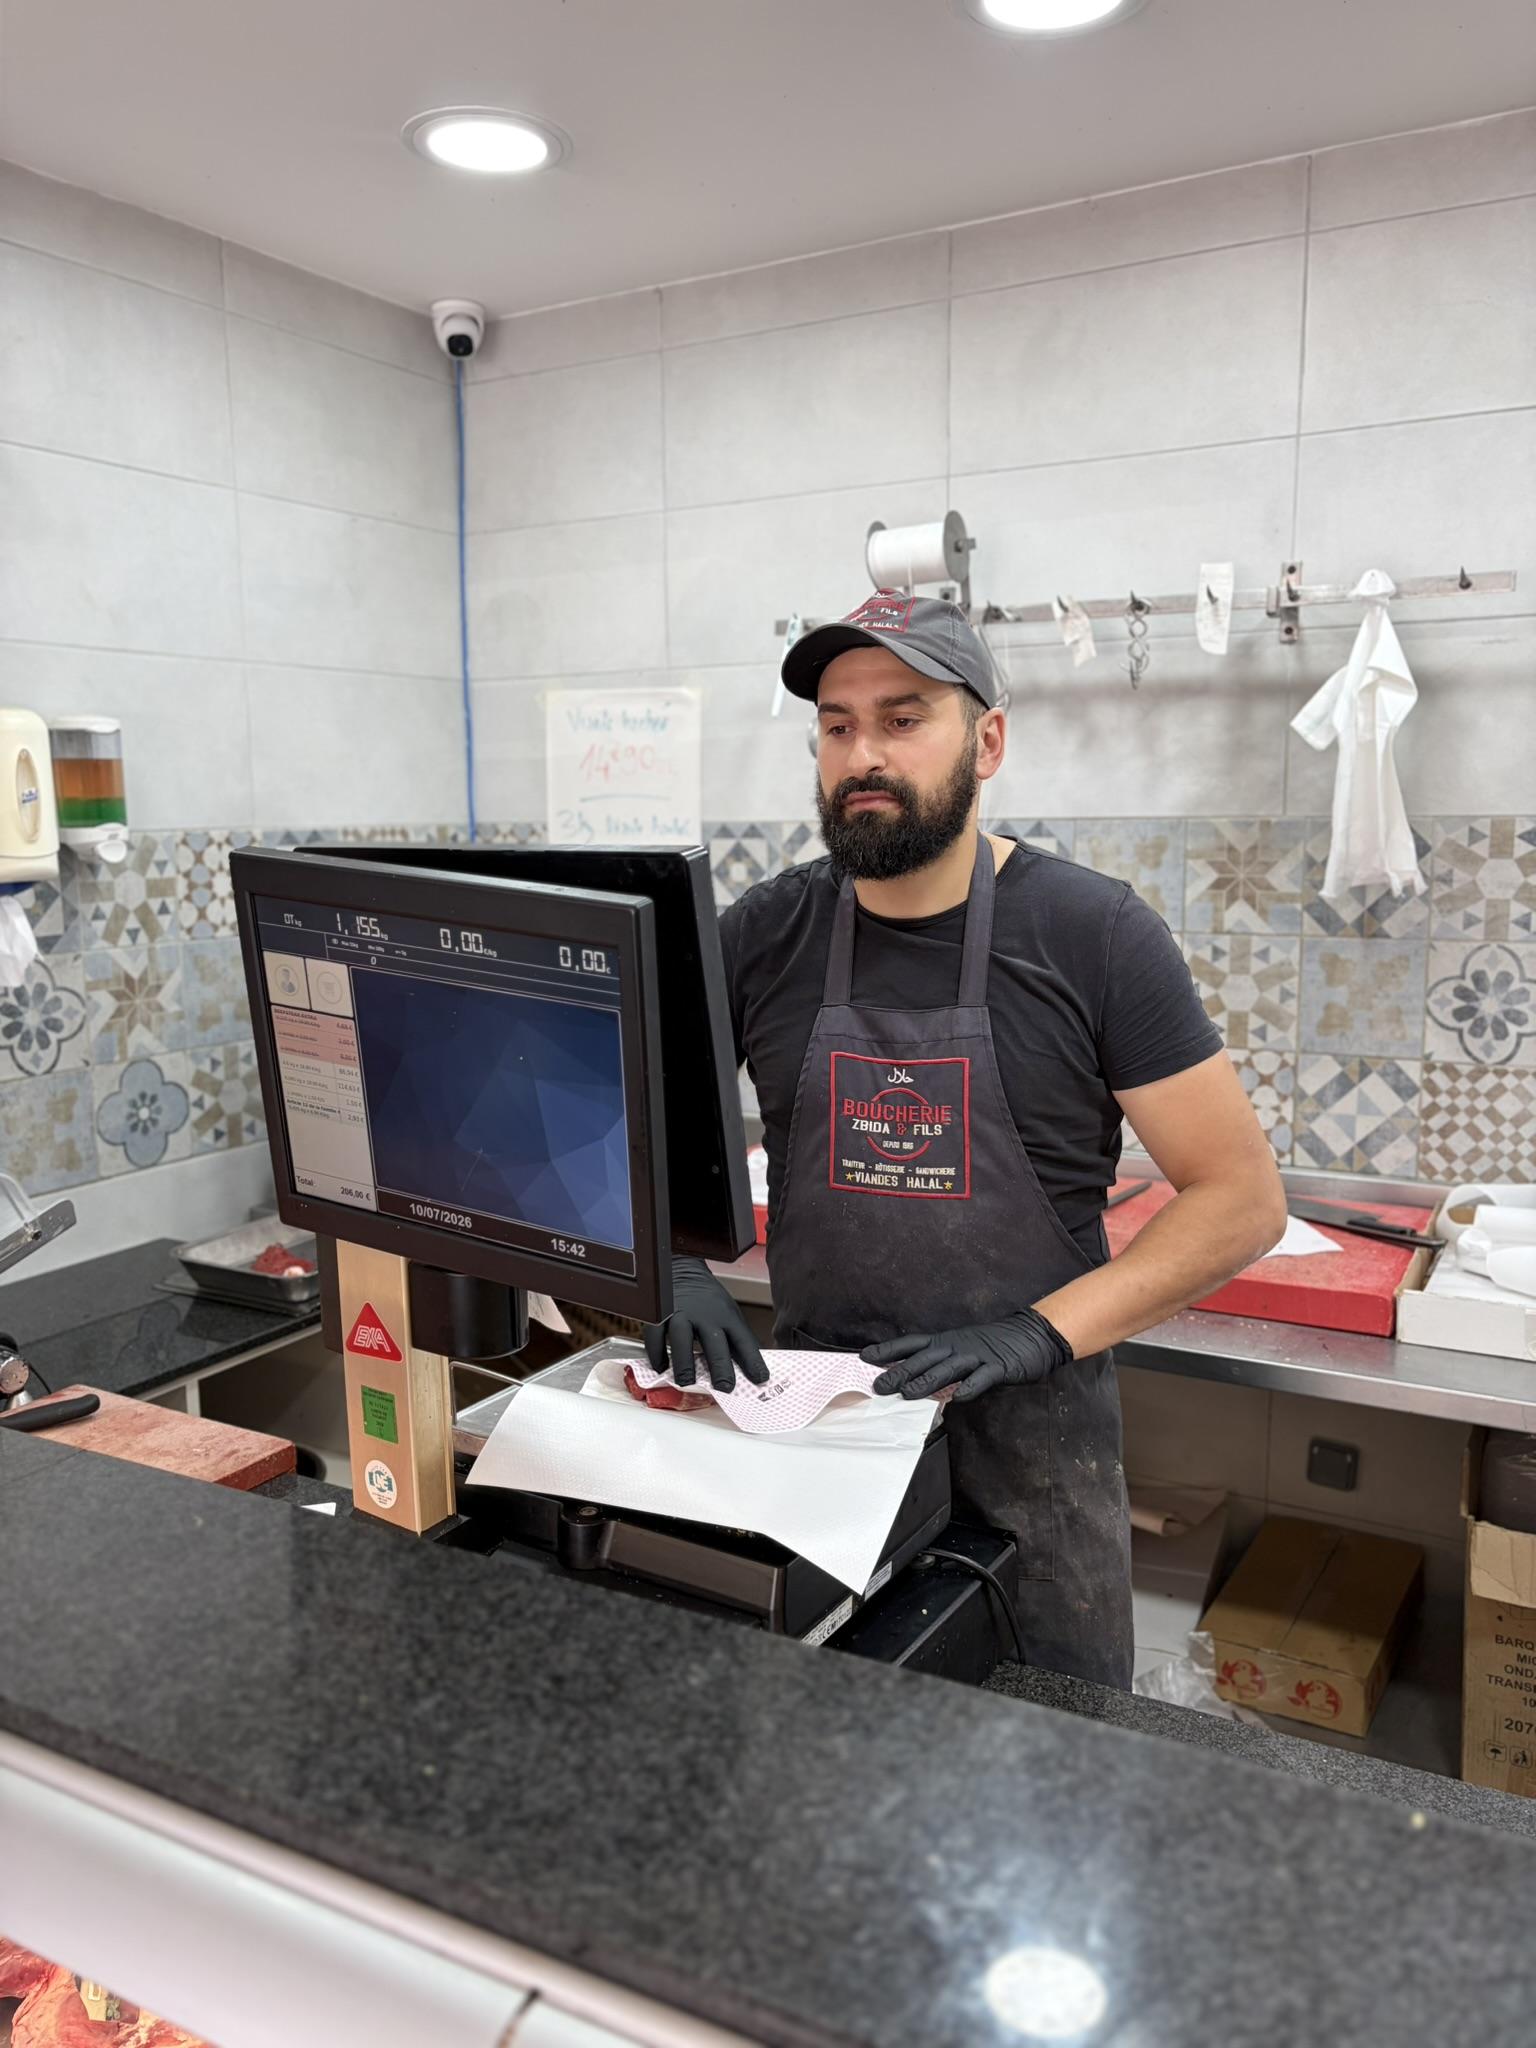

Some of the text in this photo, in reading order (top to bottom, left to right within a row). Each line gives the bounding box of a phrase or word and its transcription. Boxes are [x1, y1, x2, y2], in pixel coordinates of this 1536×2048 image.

[440, 928, 483, 953] 0,00
[559, 946, 606, 973] 0,00
[887, 1067, 914, 1084] حلال
[842, 1098, 953, 1125] BOUCHERIE
[852, 1118, 943, 1136] ZBIDA & FILS
[296, 1175, 314, 1186] Total
[854, 1171, 944, 1189] VIANDES HALAL
[340, 1186, 364, 1199] 206,00
[409, 1202, 586, 1258] 10/07/2026 15:42
[353, 1324, 391, 1353] EXA
[1495, 1634, 1535, 1651] BARQ
[1503, 1664, 1536, 1680] OND
[1504, 1717, 1536, 1735] 207
